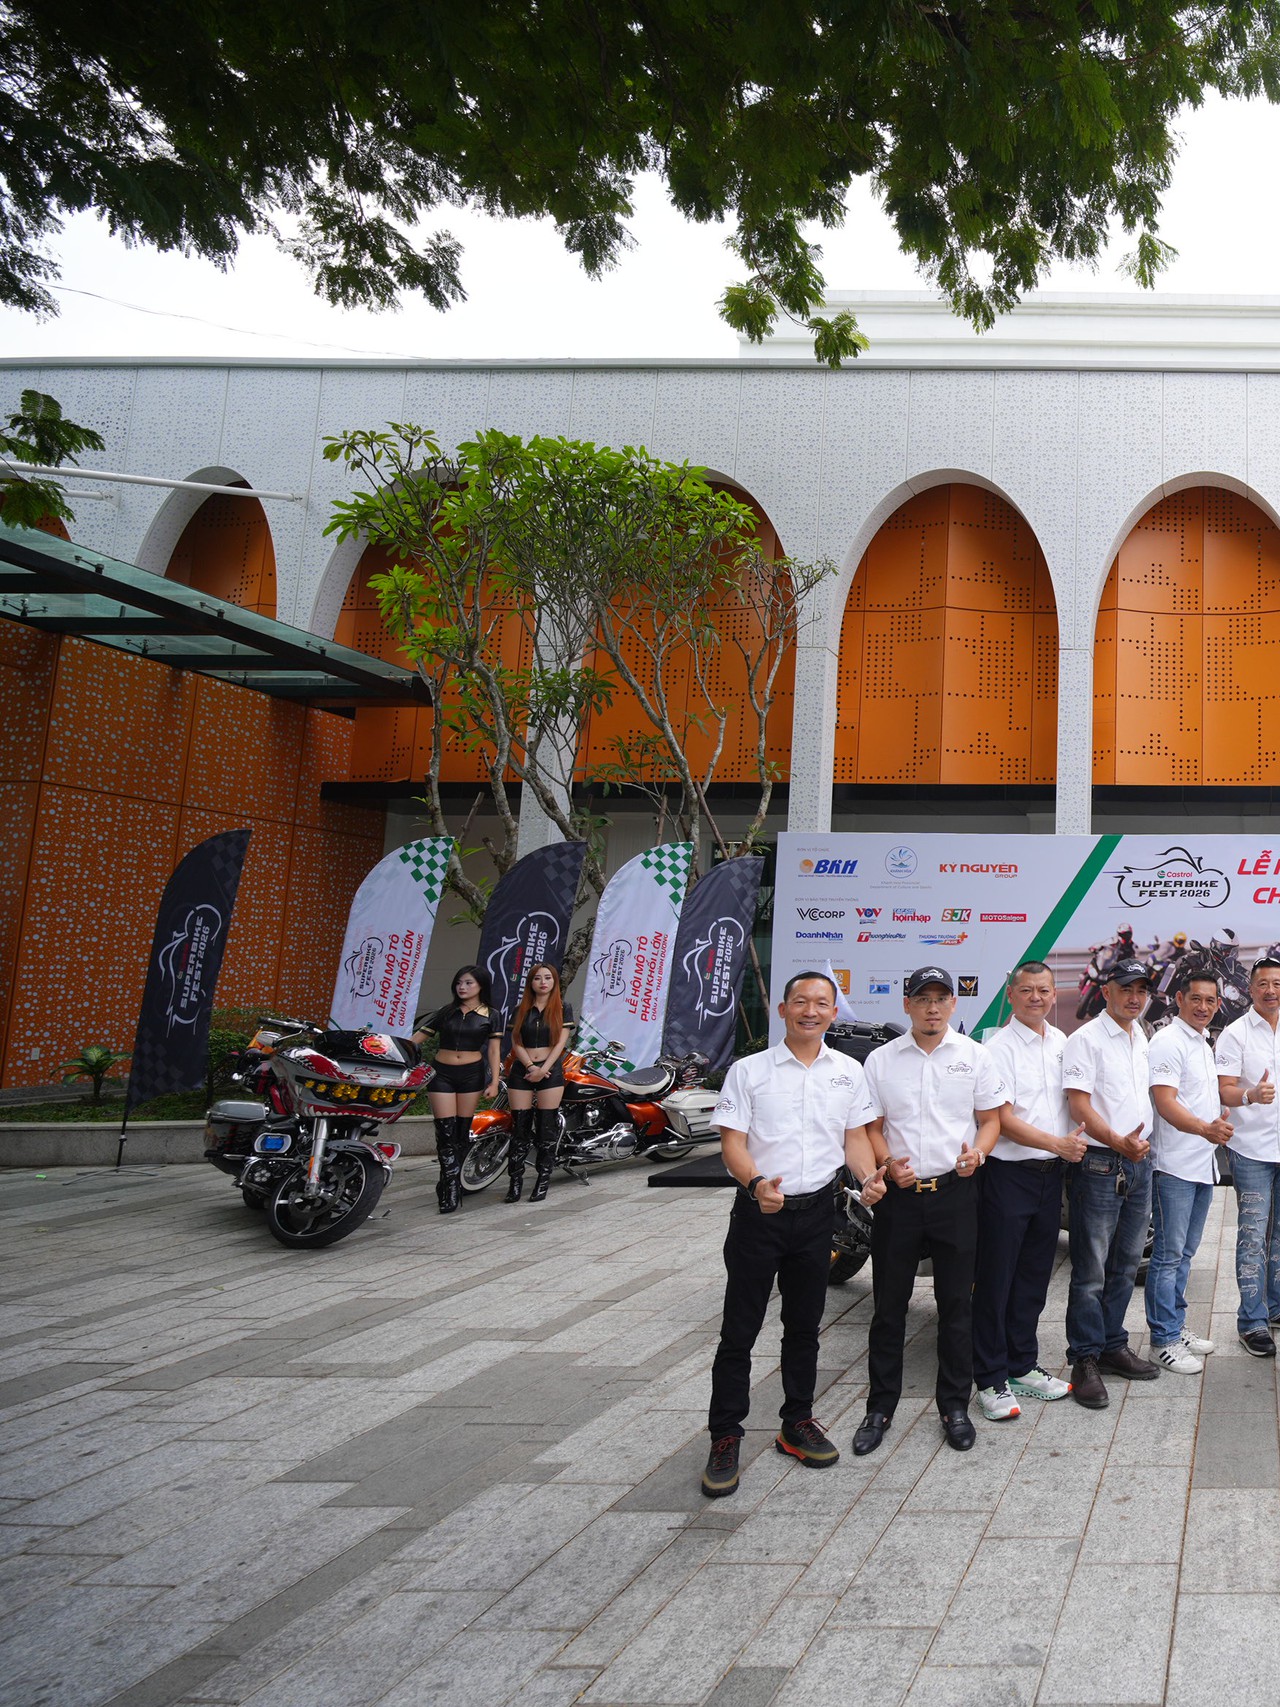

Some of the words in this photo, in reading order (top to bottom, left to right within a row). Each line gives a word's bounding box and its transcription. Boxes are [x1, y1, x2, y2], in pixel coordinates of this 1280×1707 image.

[1237, 850, 1272, 875] LỄ
[1132, 880, 1219, 888] SUPERBIKE
[1139, 890, 1178, 898] FEST
[1180, 890, 1210, 898] 2026
[856, 908, 882, 918] VOV
[943, 910, 971, 921] SJK
[388, 933, 400, 951] TÔ
[402, 930, 415, 958] LỚN
[535, 931, 548, 962] 2026
[637, 935, 648, 952] TÔ
[650, 931, 663, 956] LỚN
[724, 935, 734, 963] 2026
[180, 916, 204, 1009] SUPERBIKE
[190, 964, 203, 1002] FEST
[198, 926, 210, 959] 2026
[385, 954, 396, 976] MÔ
[396, 960, 410, 989] KHỐI
[634, 954, 646, 976] MÔ
[646, 959, 657, 987] KHỐI
[710, 926, 728, 1004] SUPERBIKE
[379, 976, 392, 999] HỘI
[630, 977, 643, 998] HỘI
[721, 964, 731, 998] FEST
[374, 999, 387, 1017] LỄ
[387, 990, 403, 1027] PHÂN
[626, 998, 638, 1014] LỄ
[640, 988, 653, 1022] PHÂN
